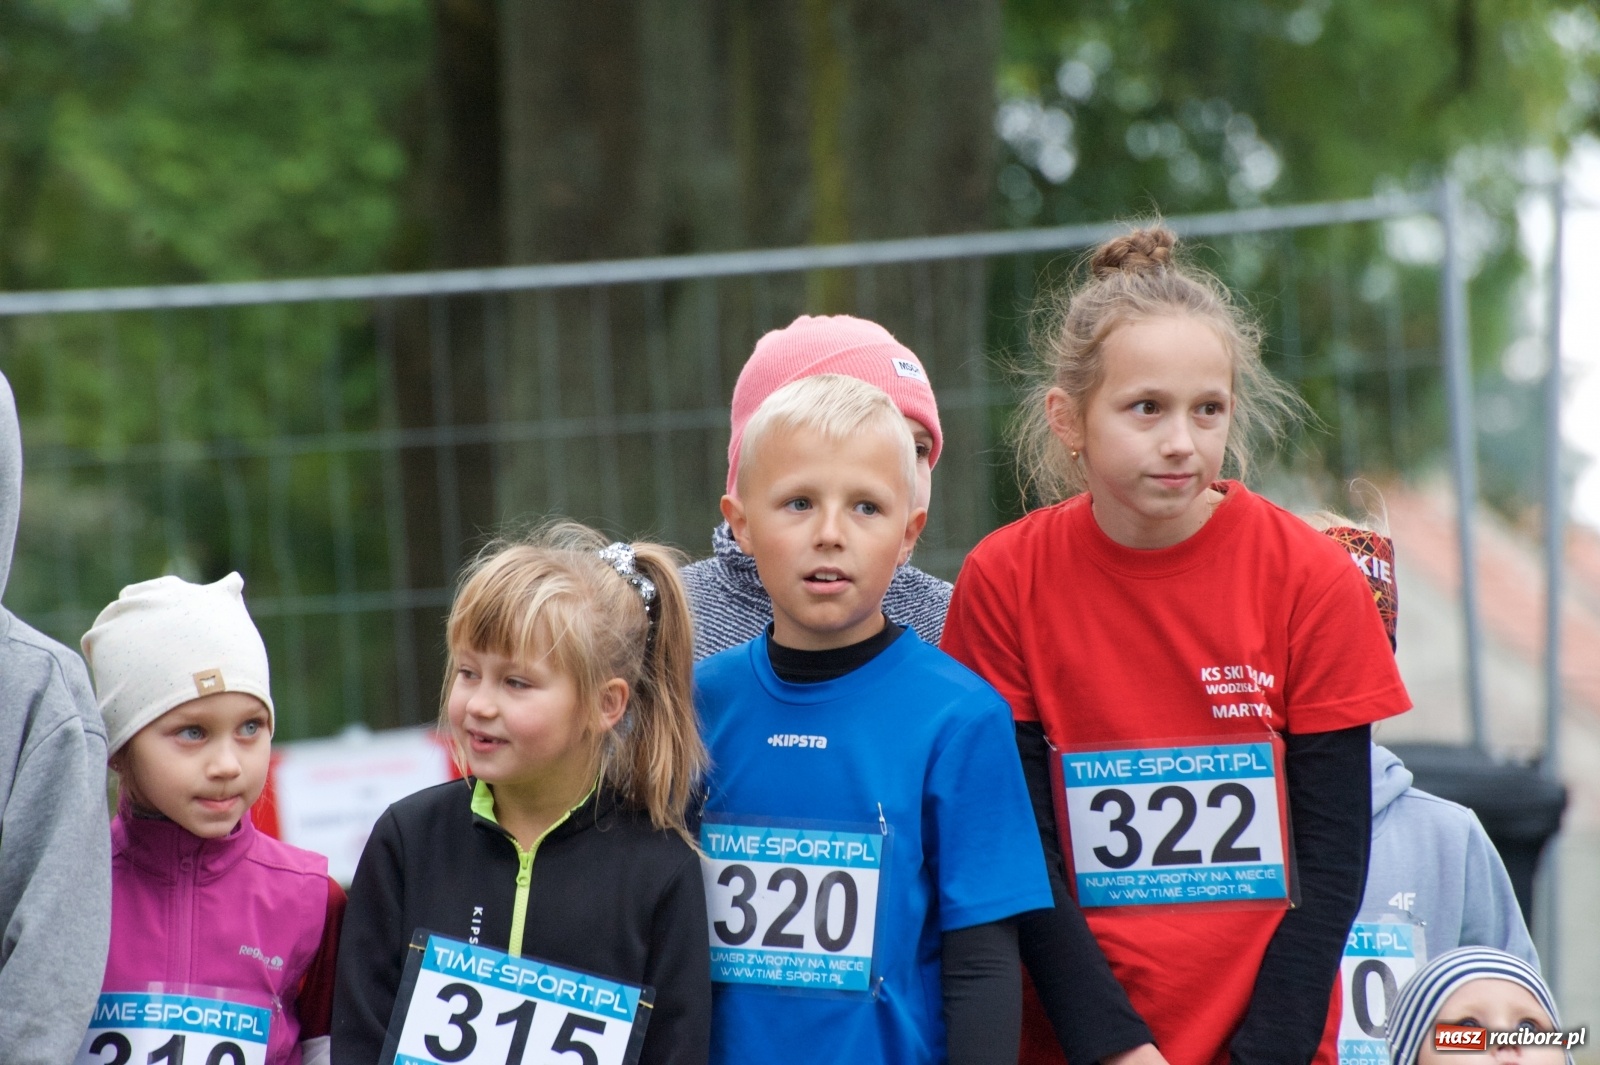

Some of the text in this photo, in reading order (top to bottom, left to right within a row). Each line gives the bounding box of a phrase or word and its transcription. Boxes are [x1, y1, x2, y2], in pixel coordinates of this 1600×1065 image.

[1350, 552, 1392, 584] KIE
[1201, 667, 1221, 682] KS
[1223, 665, 1244, 680] SKI
[1070, 752, 1267, 779] TIME-SPORT.PL
[1089, 782, 1262, 869] 322
[707, 833, 875, 862] TIME-SPORT.PL
[1085, 868, 1277, 887] NUMER ZWROTNY NA MECIE
[713, 864, 858, 952] 320
[1388, 892, 1417, 911] 4F
[469, 905, 484, 945] KIPS
[1347, 932, 1407, 950] RT.PL
[710, 951, 864, 972] UMER ZWROTNY NA MECIE
[433, 945, 628, 1014] TIME-SPORT.PL
[1352, 959, 1399, 1039] 0
[93, 1002, 264, 1036] IME-SPORT.PL
[423, 982, 607, 1065] 315
